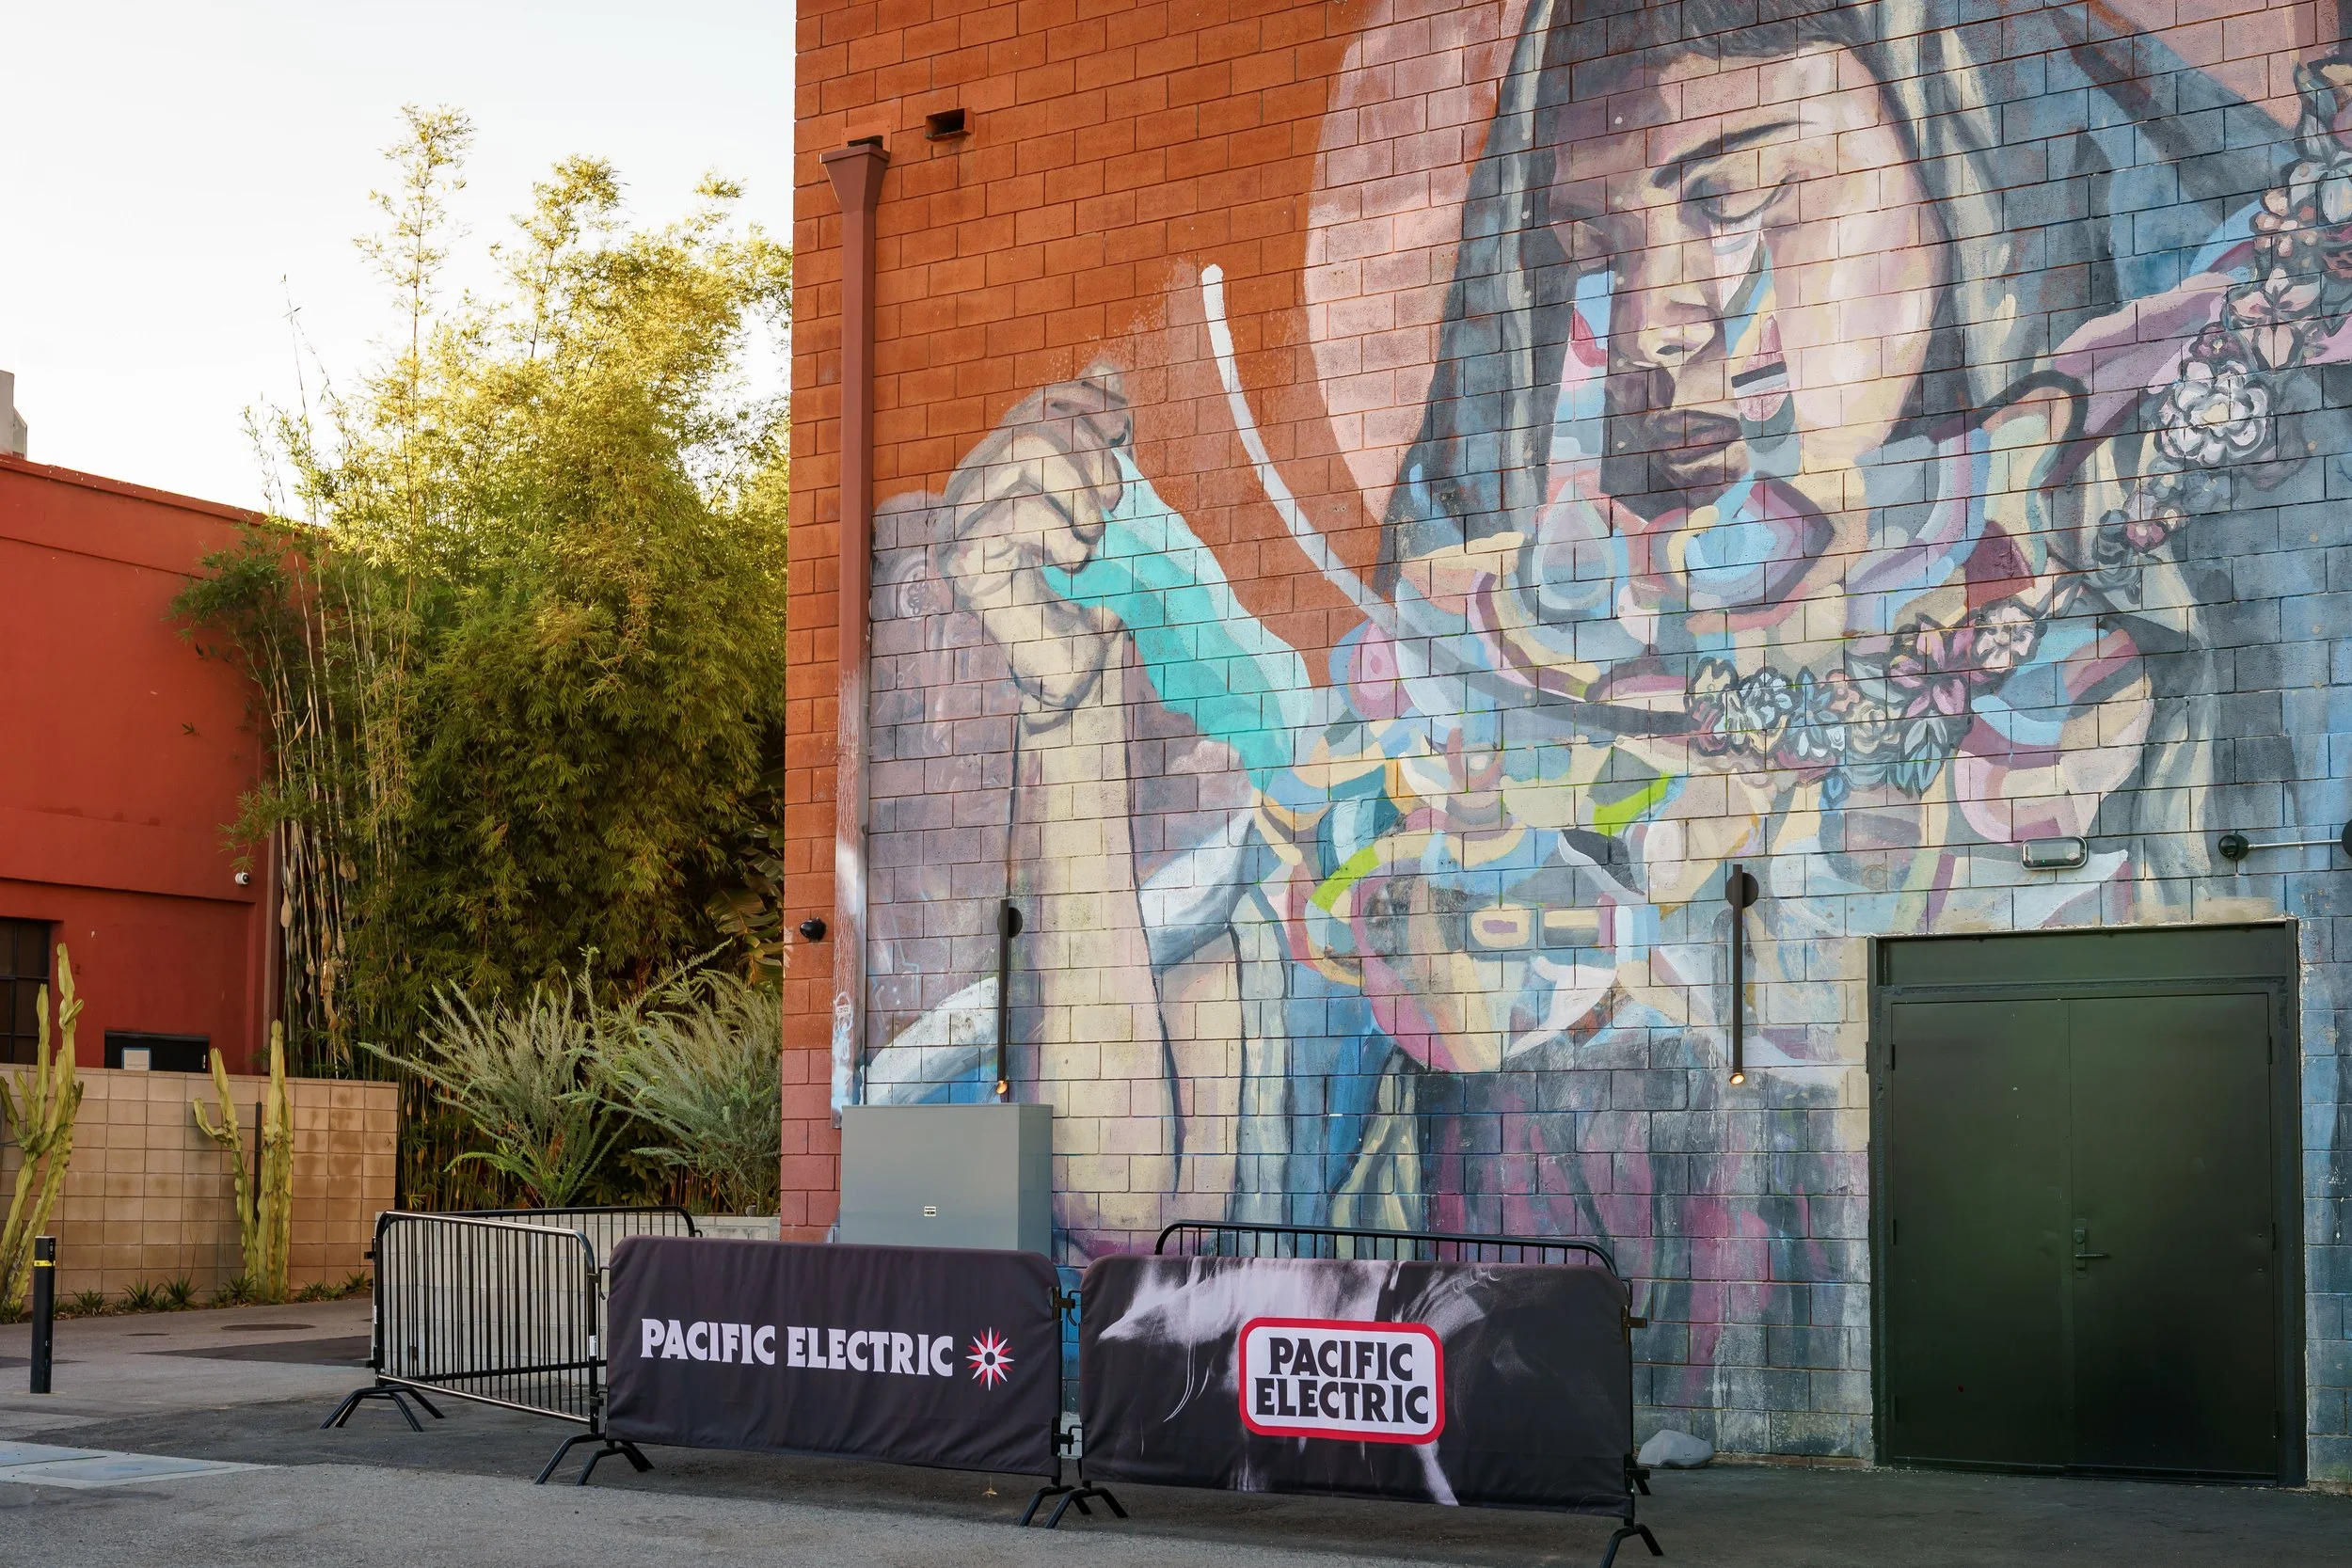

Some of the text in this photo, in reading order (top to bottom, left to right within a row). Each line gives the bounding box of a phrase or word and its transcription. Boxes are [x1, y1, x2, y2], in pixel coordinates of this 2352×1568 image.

[641, 1319, 775, 1365] PACIFIC
[787, 1326, 953, 1376] ELECTRIC
[1269, 1338, 1413, 1381] PACIFIC
[1255, 1378, 1429, 1424] ELECTRIC
